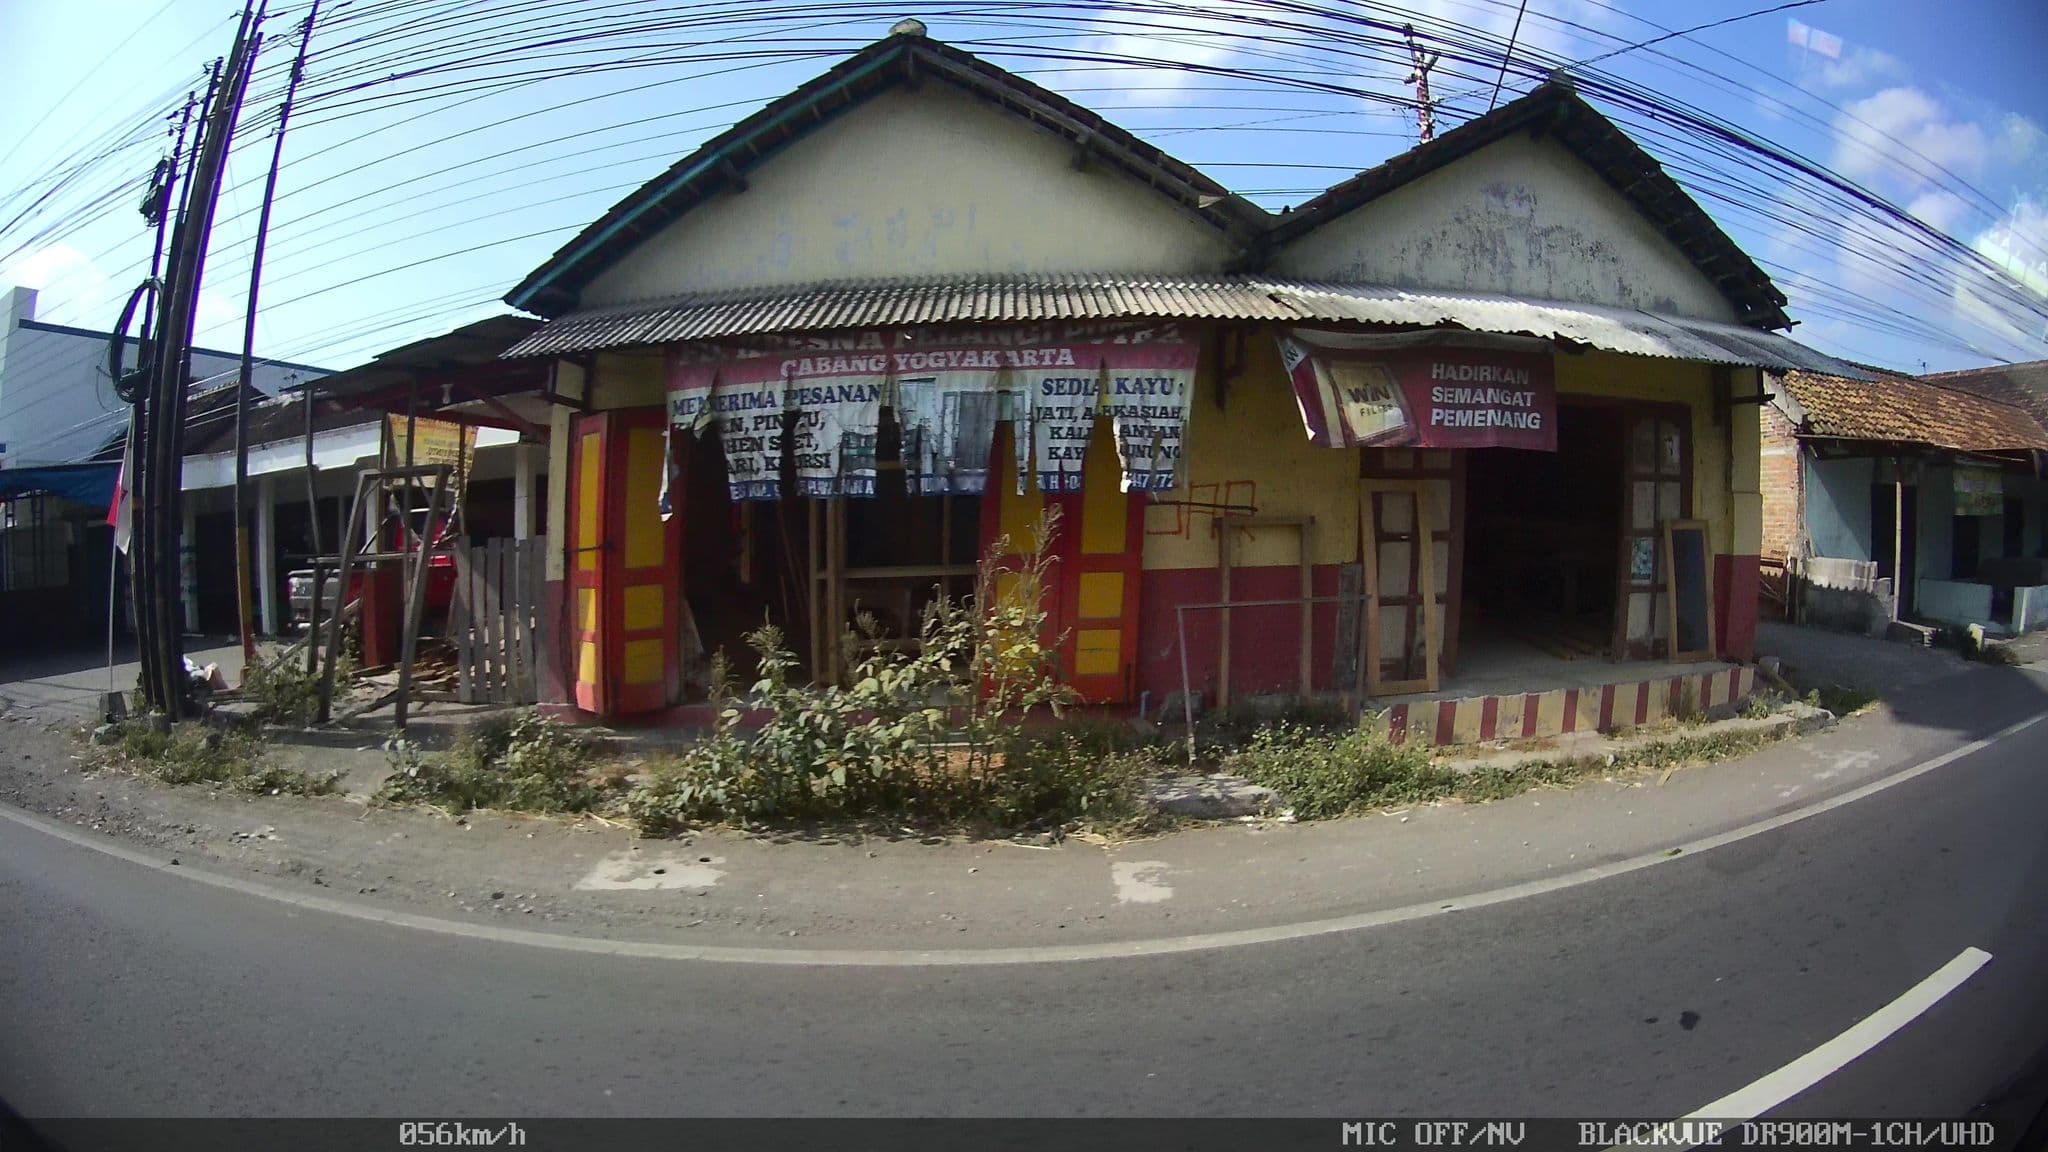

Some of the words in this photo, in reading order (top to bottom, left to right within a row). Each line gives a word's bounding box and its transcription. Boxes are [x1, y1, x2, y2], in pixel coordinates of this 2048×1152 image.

[780, 355, 888, 377] CABANG
[893, 348, 1076, 371] YOGYAKARTA
[1432, 363, 1530, 385] HADIRKAN
[783, 384, 882, 408] PESANAN
[1042, 377, 1109, 396] SEDIA
[1432, 386, 1536, 408] SEMANGAT
[1430, 408, 1542, 430] PEMENANG
